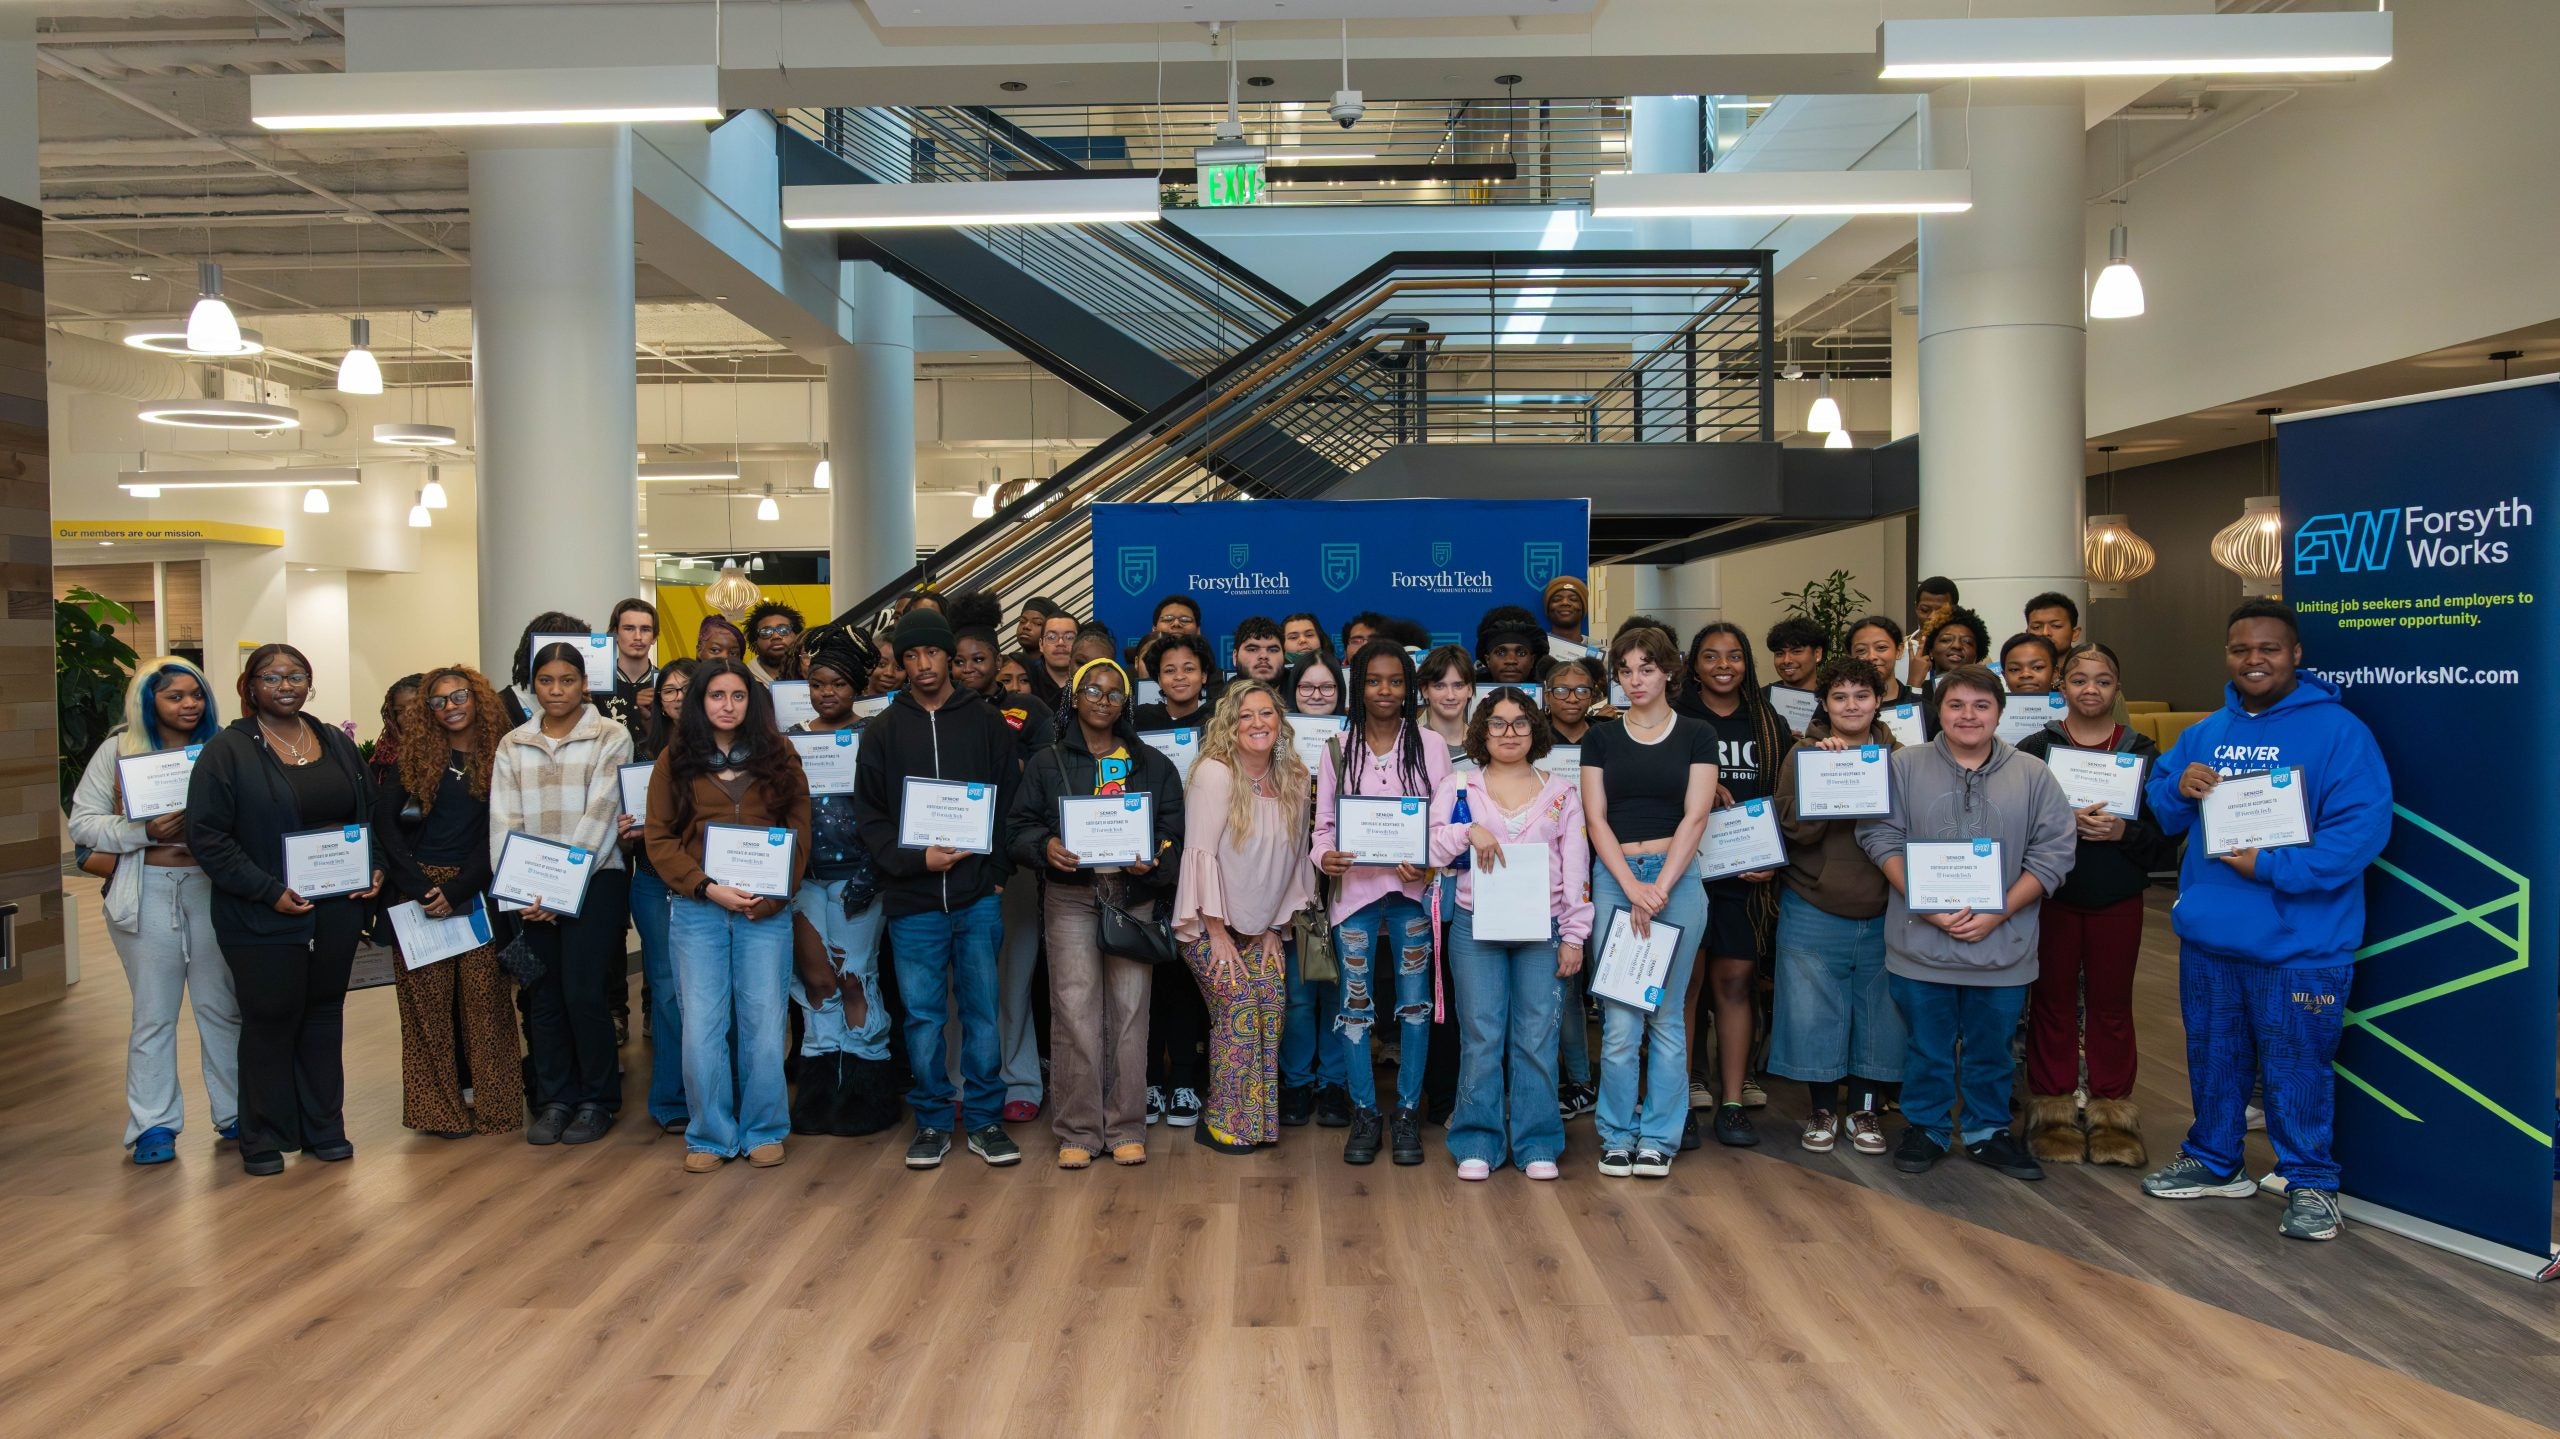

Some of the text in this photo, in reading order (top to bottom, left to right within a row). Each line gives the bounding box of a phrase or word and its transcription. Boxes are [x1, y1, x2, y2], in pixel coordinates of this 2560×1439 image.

[1208, 165, 1258, 205] EXIT
[2405, 497, 2532, 537] Forsyth
[60, 529, 78, 537] Our
[2407, 539, 2508, 568] Works
[1188, 572, 1290, 593] Forsyth Tech
[1391, 571, 1492, 591] Forsyth Tech
[2296, 592, 2533, 613] Uniting job seekers and employers to
[2338, 613, 2481, 629] empower opportunity.
[2214, 745, 2280, 761] CARVER
[2292, 992, 2335, 1004] MILANO
